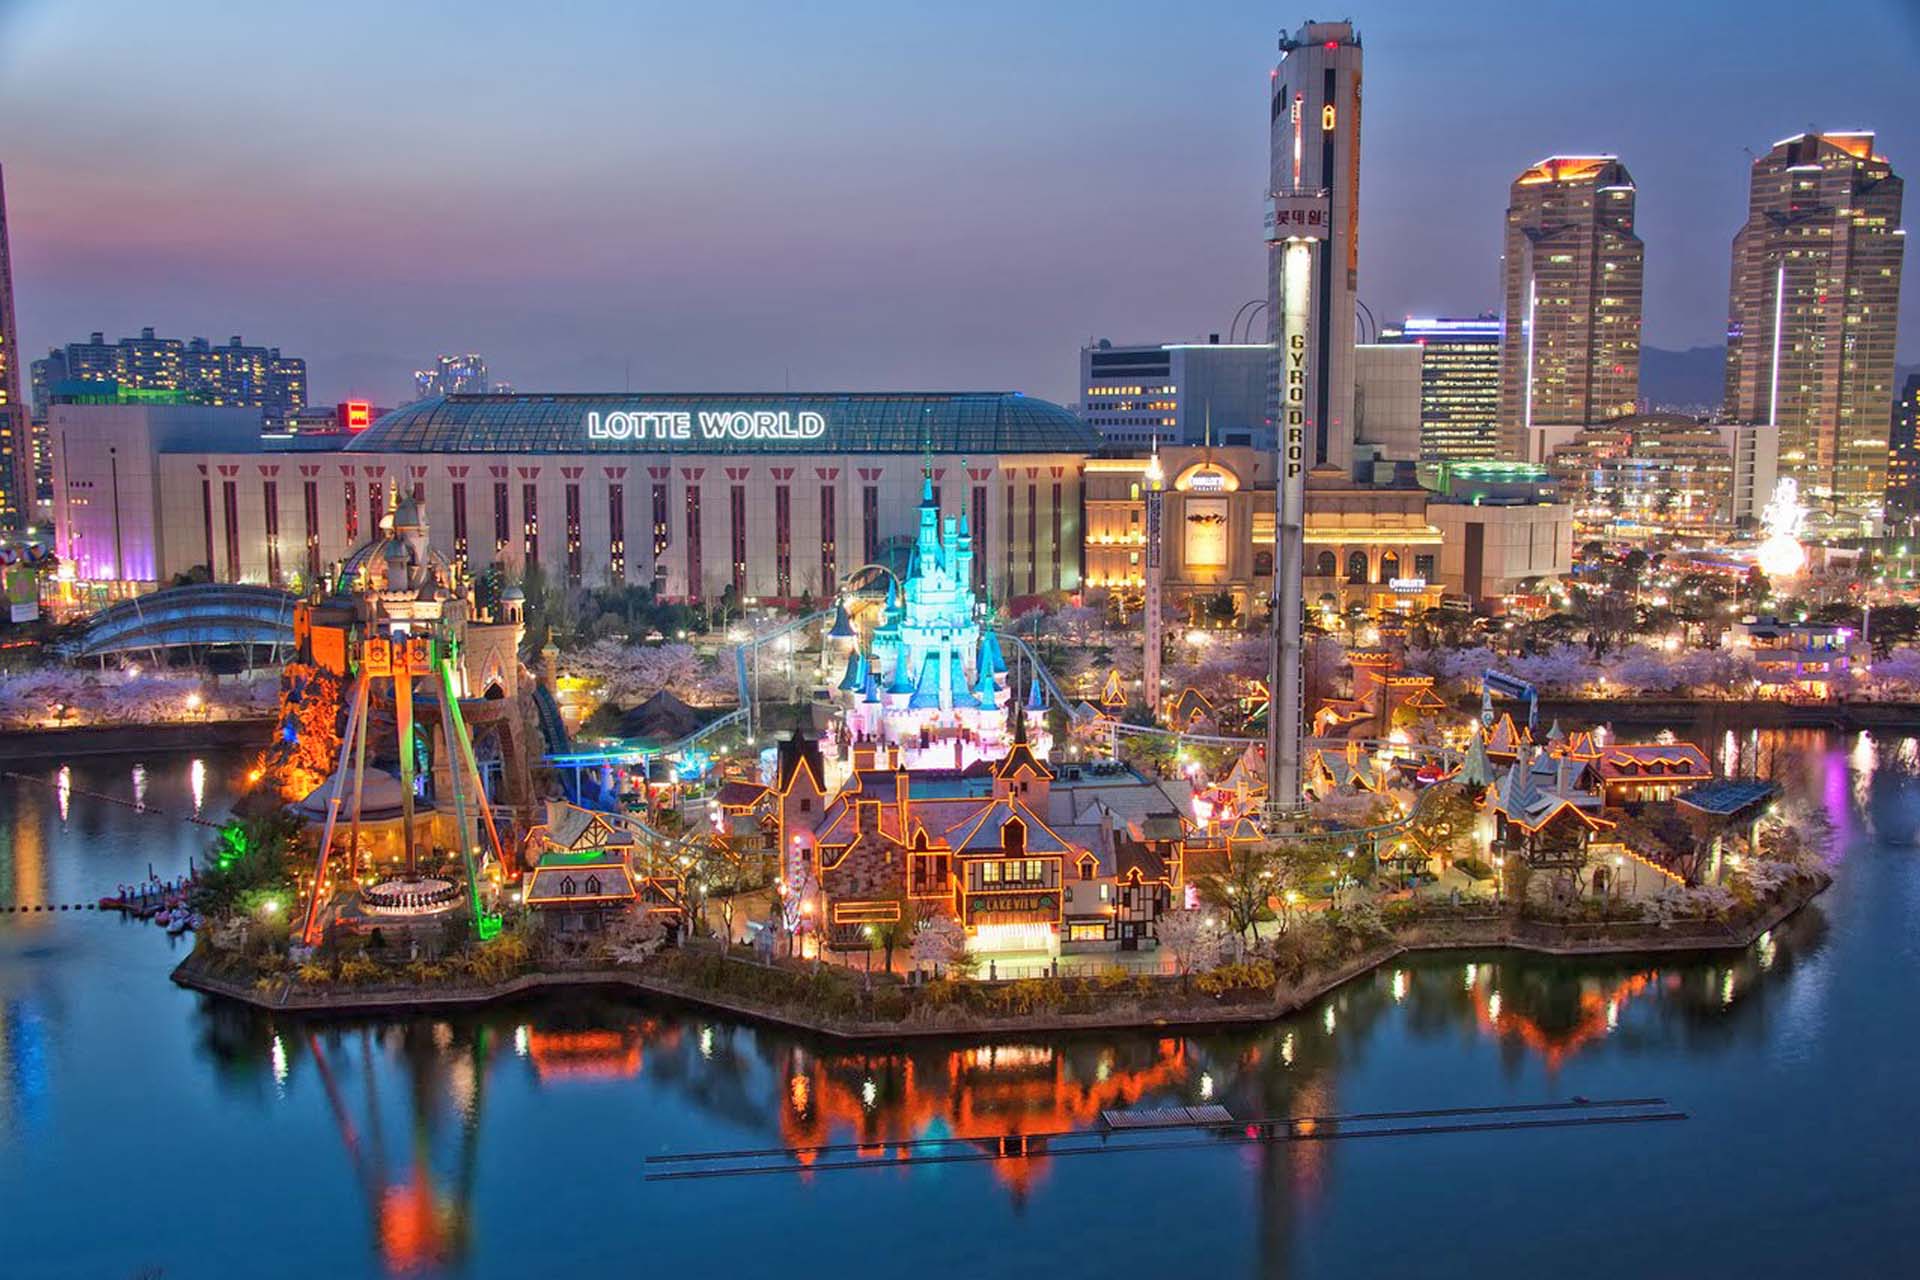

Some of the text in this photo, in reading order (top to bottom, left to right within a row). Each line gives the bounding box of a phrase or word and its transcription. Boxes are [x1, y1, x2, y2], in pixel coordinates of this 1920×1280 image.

[588, 411, 825, 440] LOTTE WORLD
[1288, 335, 1304, 478] GYRO DROP
